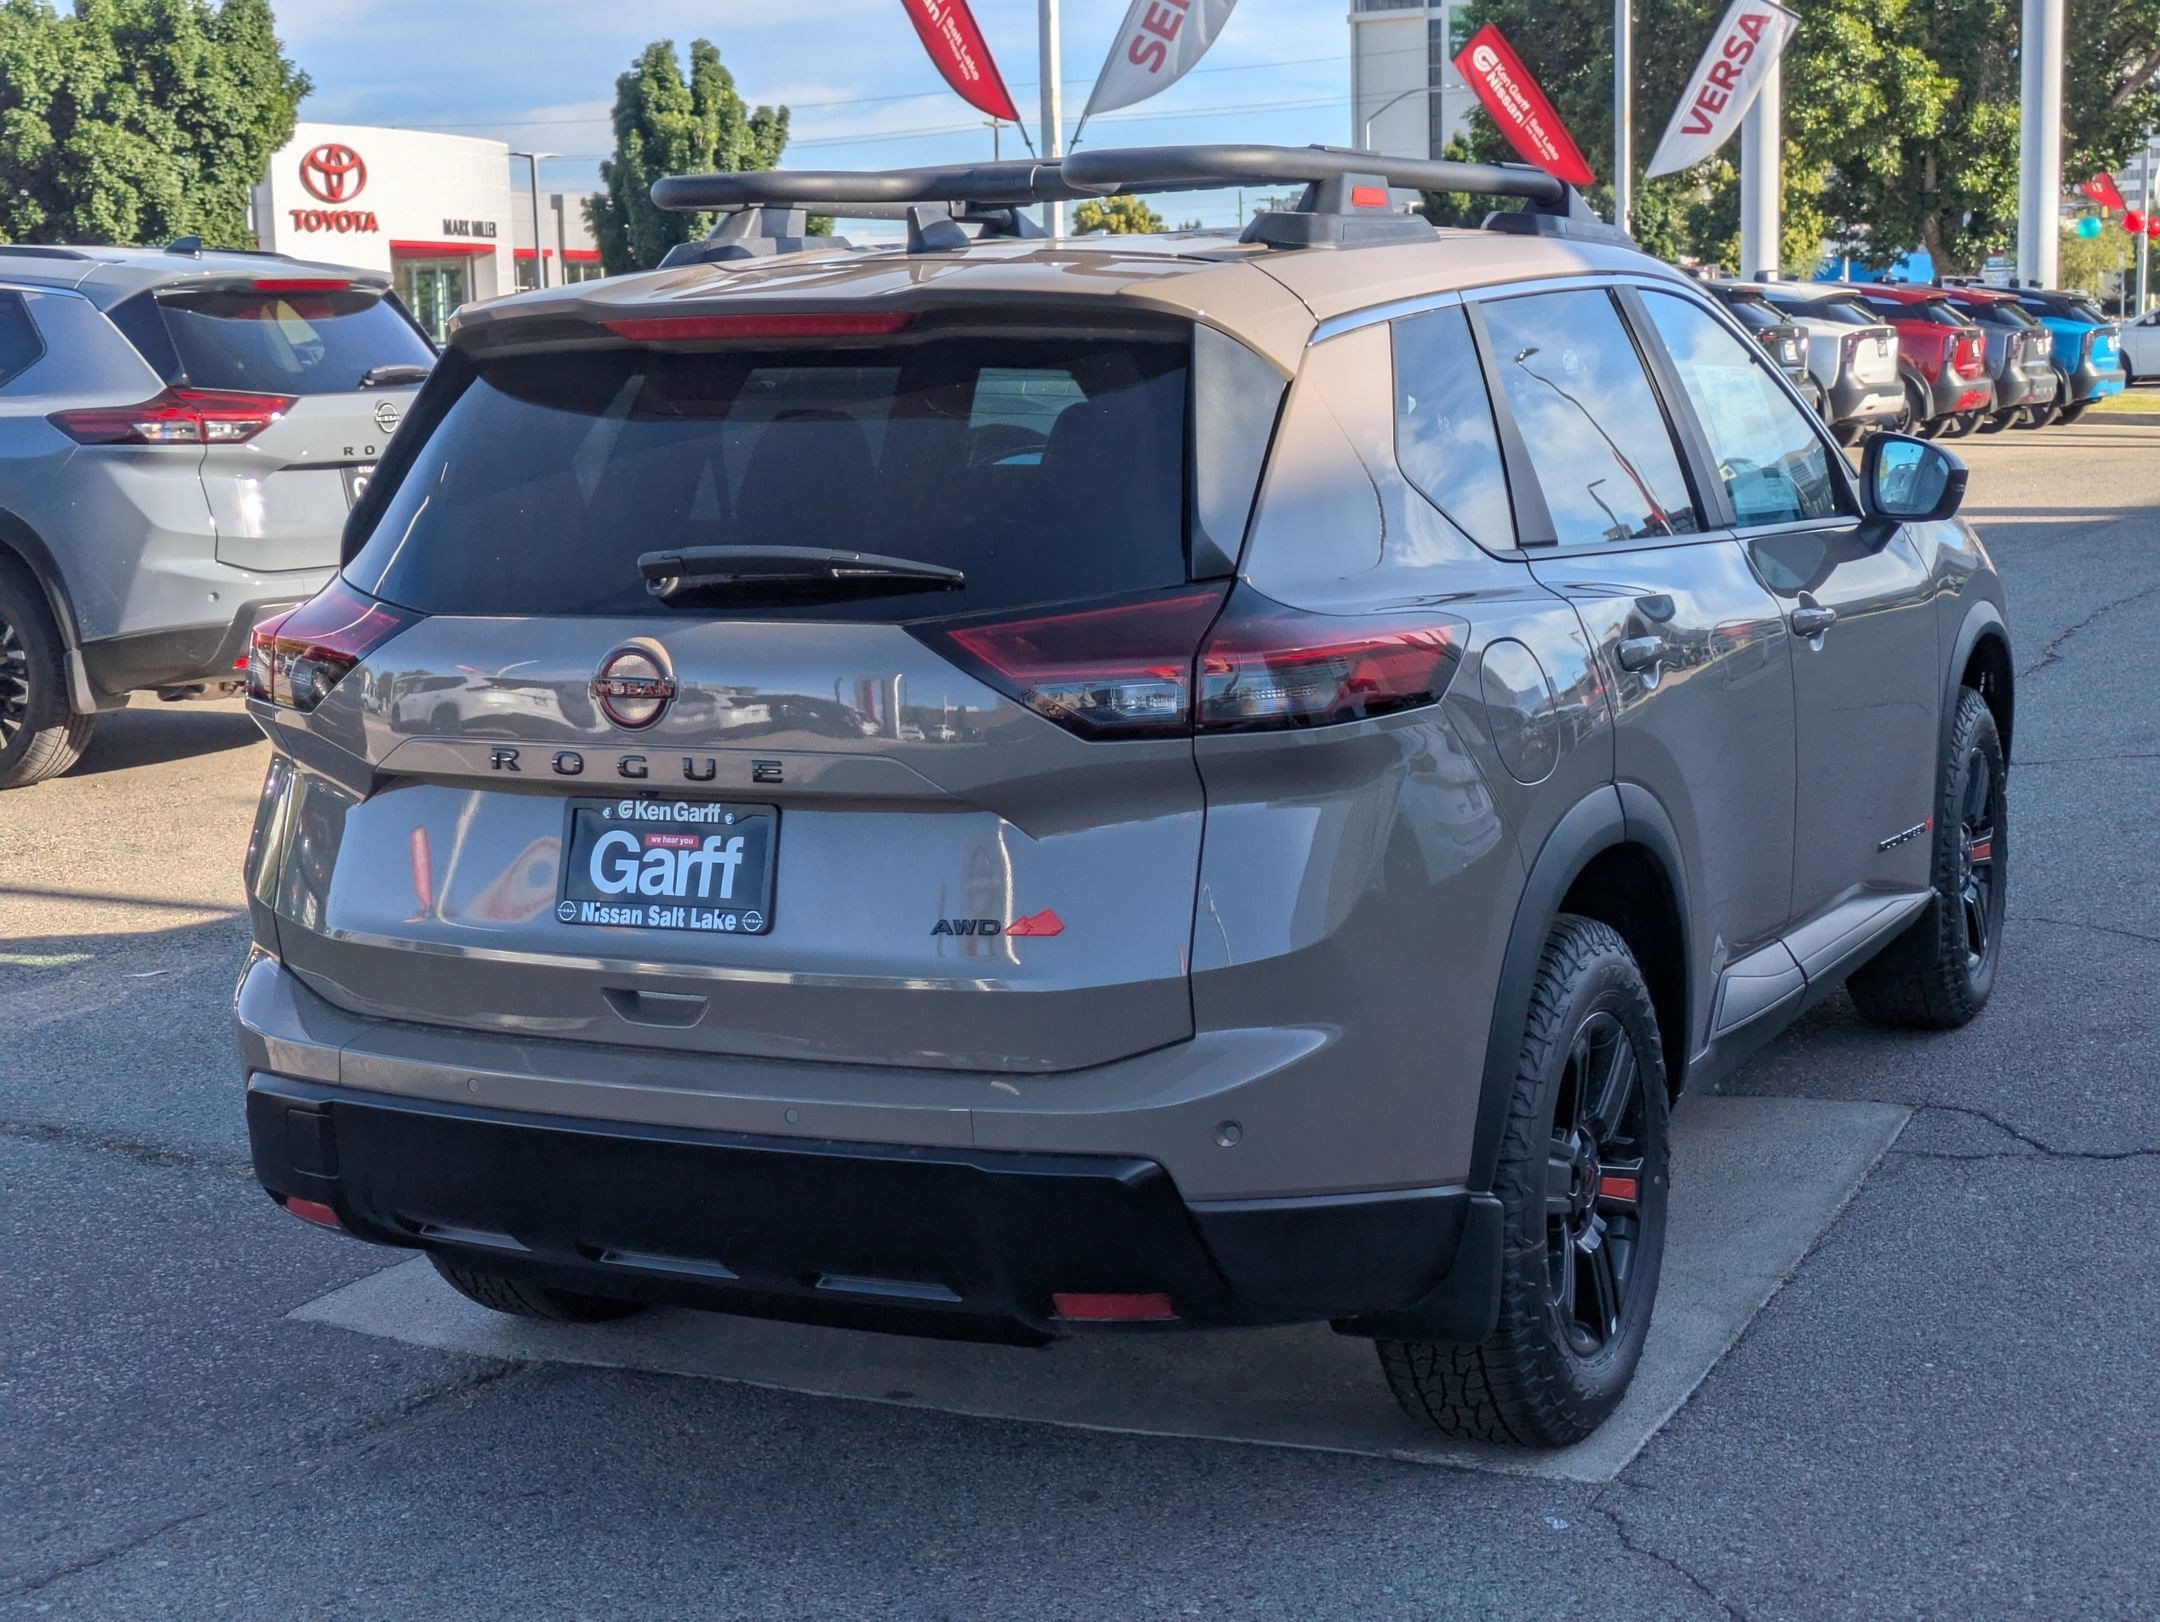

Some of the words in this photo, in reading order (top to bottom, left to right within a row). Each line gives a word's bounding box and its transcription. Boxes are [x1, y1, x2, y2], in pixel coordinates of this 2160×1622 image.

[946, 16, 963, 47] Salt
[960, 44, 979, 80] Lake
[1494, 62, 1512, 88] Ken
[1508, 84, 1530, 112] Garff
[1680, 14, 1772, 135] VERSA
[1486, 71, 1524, 124] Nissan
[1541, 135, 1559, 160] Lake
[288, 209, 380, 234] TOYOTA
[443, 218, 470, 236] MARK
[489, 747, 784, 784] ROGUE
[634, 801, 671, 821] Ken
[673, 801, 721, 823] Garff
[650, 836, 662, 844] we
[662, 835, 678, 845] hear
[678, 836, 694, 846] you
[589, 829, 745, 899] Garff
[581, 901, 643, 925] Nissan
[647, 904, 686, 928] Salt
[690, 907, 737, 931] Lake
[930, 919, 1001, 936] AWD
